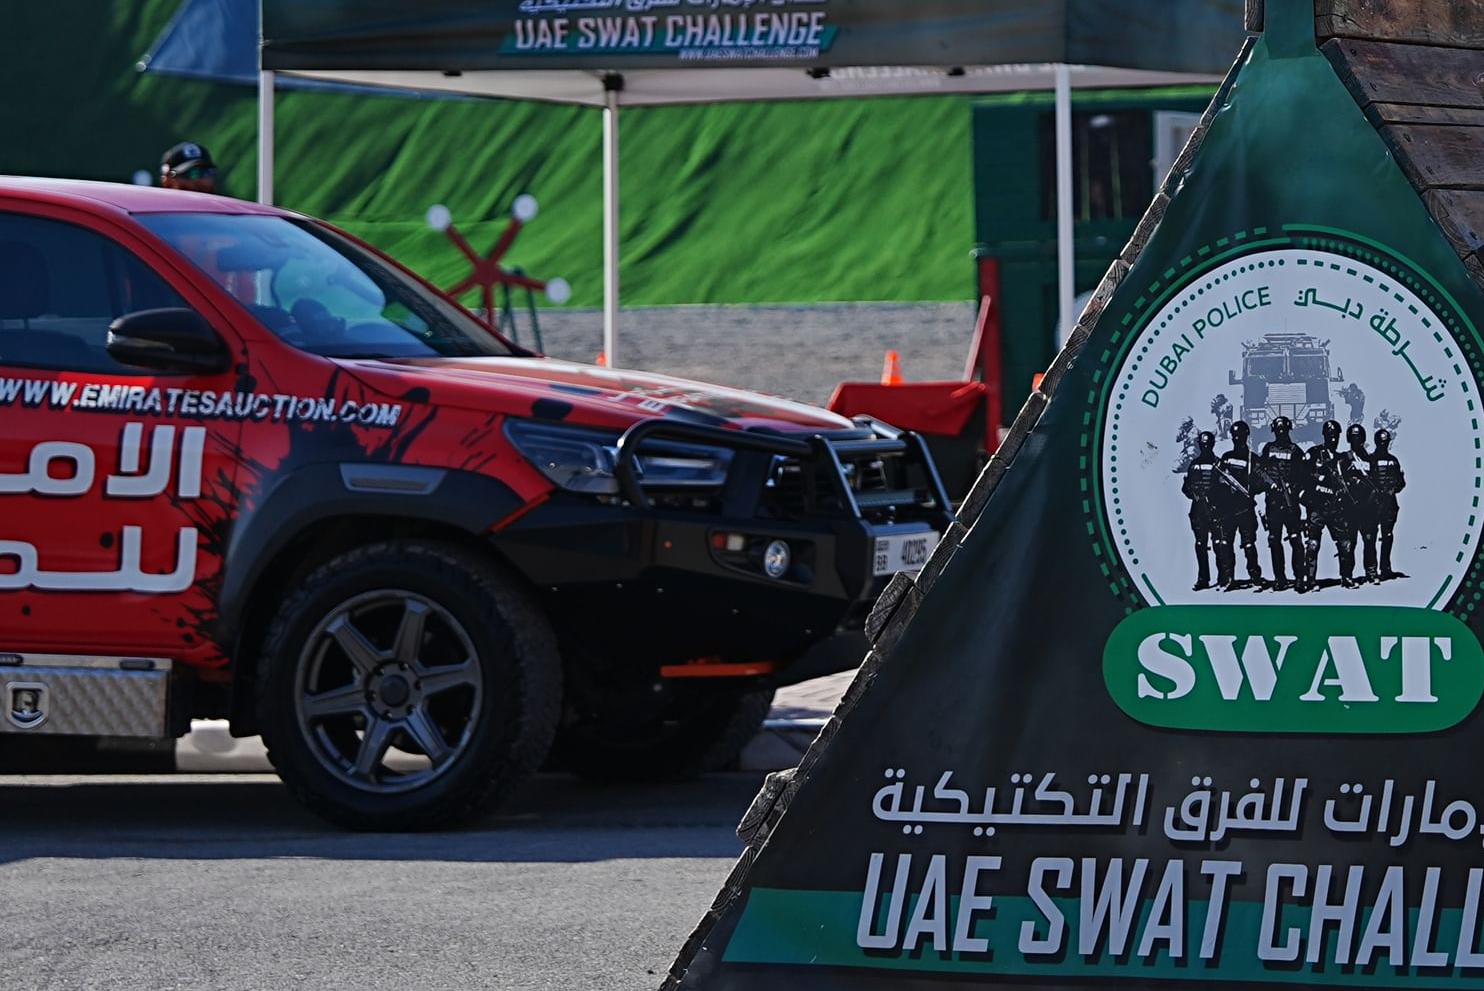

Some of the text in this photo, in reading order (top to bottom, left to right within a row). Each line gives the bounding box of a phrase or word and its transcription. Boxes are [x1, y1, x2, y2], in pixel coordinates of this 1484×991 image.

[514, 11, 826, 50] UAE SWAT CHALLENGE
[1141, 286, 1272, 408] DUBAI POLICE
[1293, 287, 1447, 402] شرطة دبي
[0, 377, 402, 426] WWW.EMIRATESAUCTION.COM
[0, 421, 207, 498] الام
[1137, 631, 1452, 703] SWAT
[871, 766, 1148, 836] التكتيكية
[1163, 776, 1308, 841] للفرق
[855, 851, 1002, 953] UAE
[1018, 856, 1243, 959] SWAT
